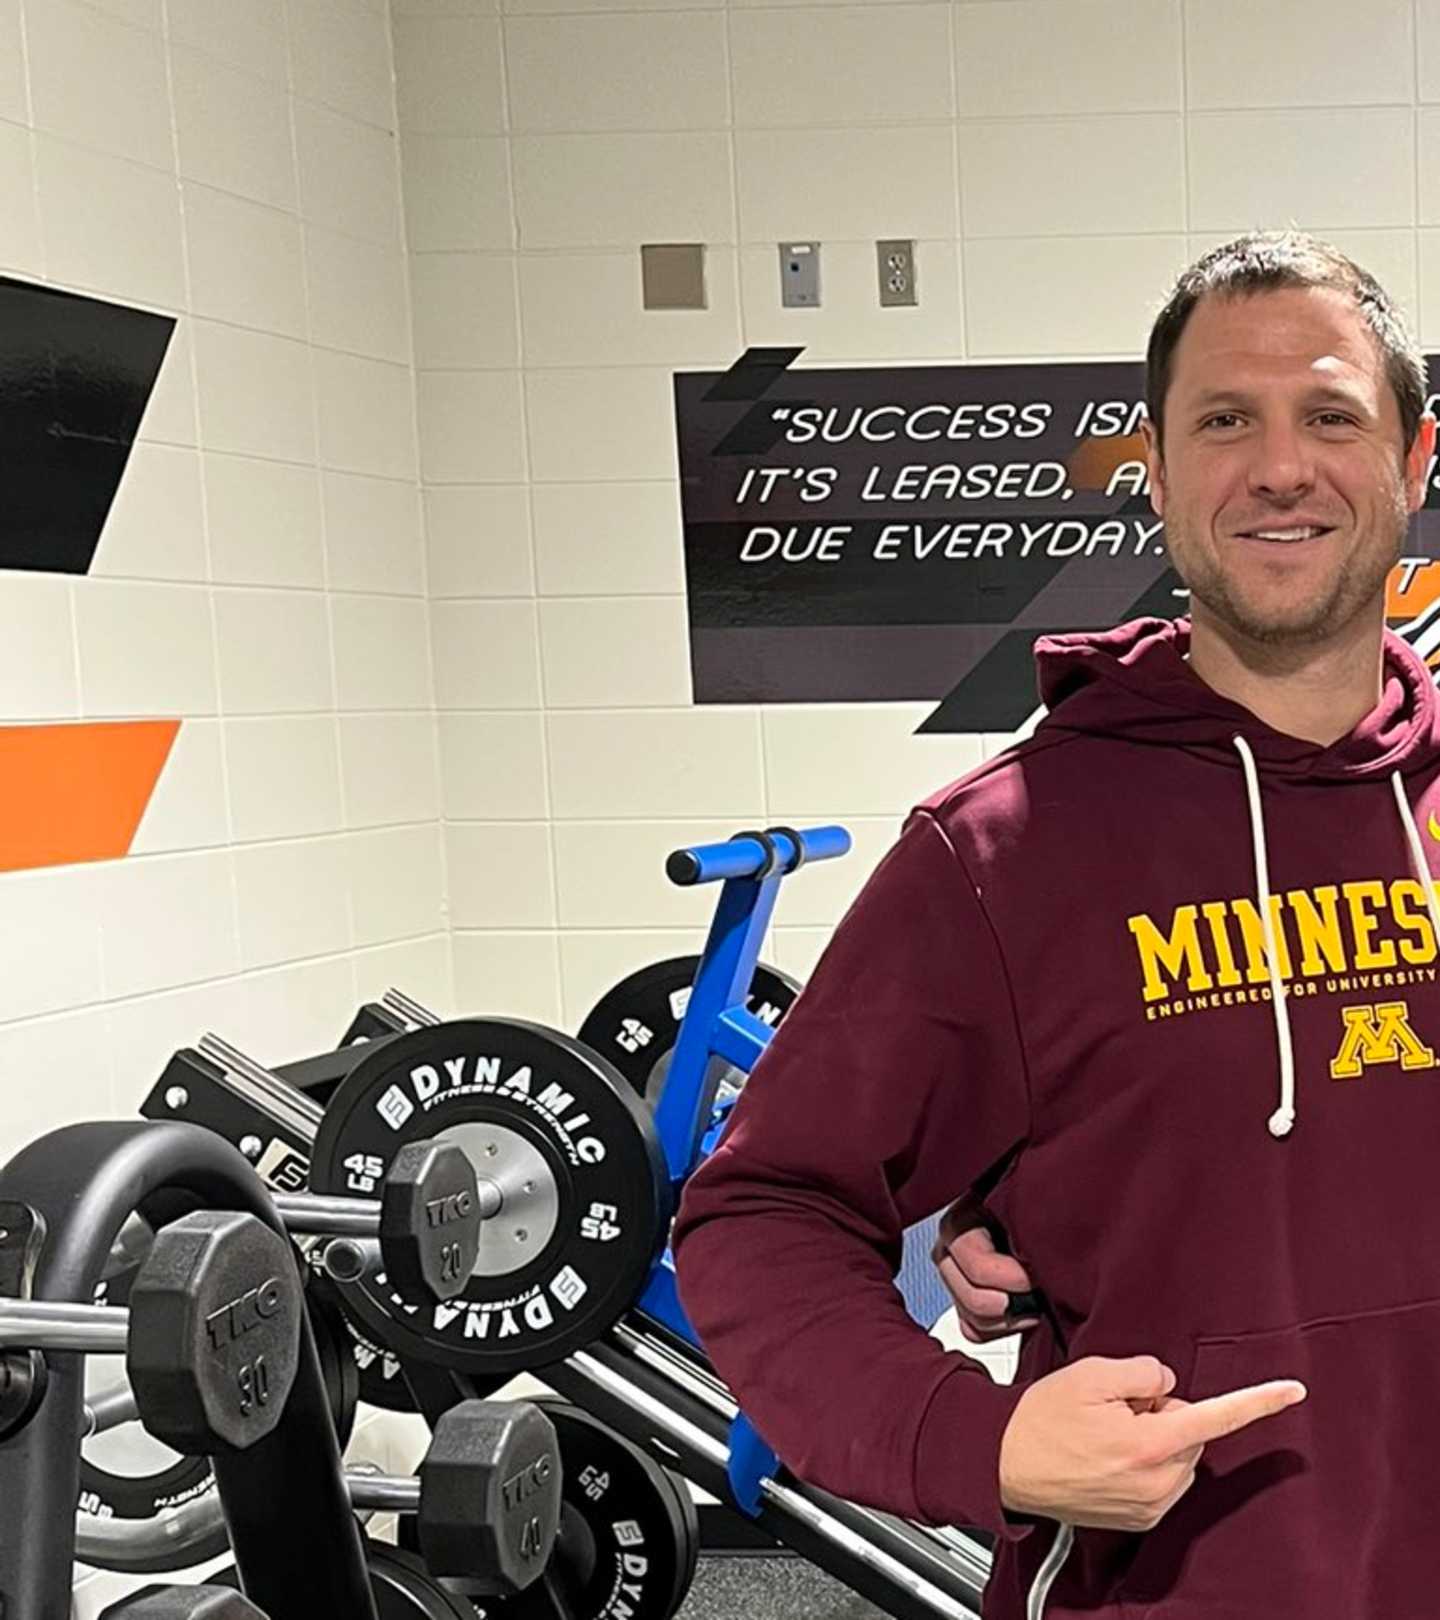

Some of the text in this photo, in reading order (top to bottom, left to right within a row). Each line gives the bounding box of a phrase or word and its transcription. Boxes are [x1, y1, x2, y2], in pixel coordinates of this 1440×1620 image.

[736, 467, 838, 503] IT'S
[861, 462, 1074, 501] LEASED,
[740, 526, 852, 561] DUE
[1146, 986, 1272, 1021] ENGINEERED
[1326, 968, 1436, 992] UNIVERSITY
[1329, 1001, 1435, 1079] M
[410, 1056, 606, 1164] DYNAMIC
[344, 1153, 384, 1179] 45
[347, 1172, 375, 1193] LB
[580, 1217, 622, 1242] 45
[590, 1202, 618, 1222] LB
